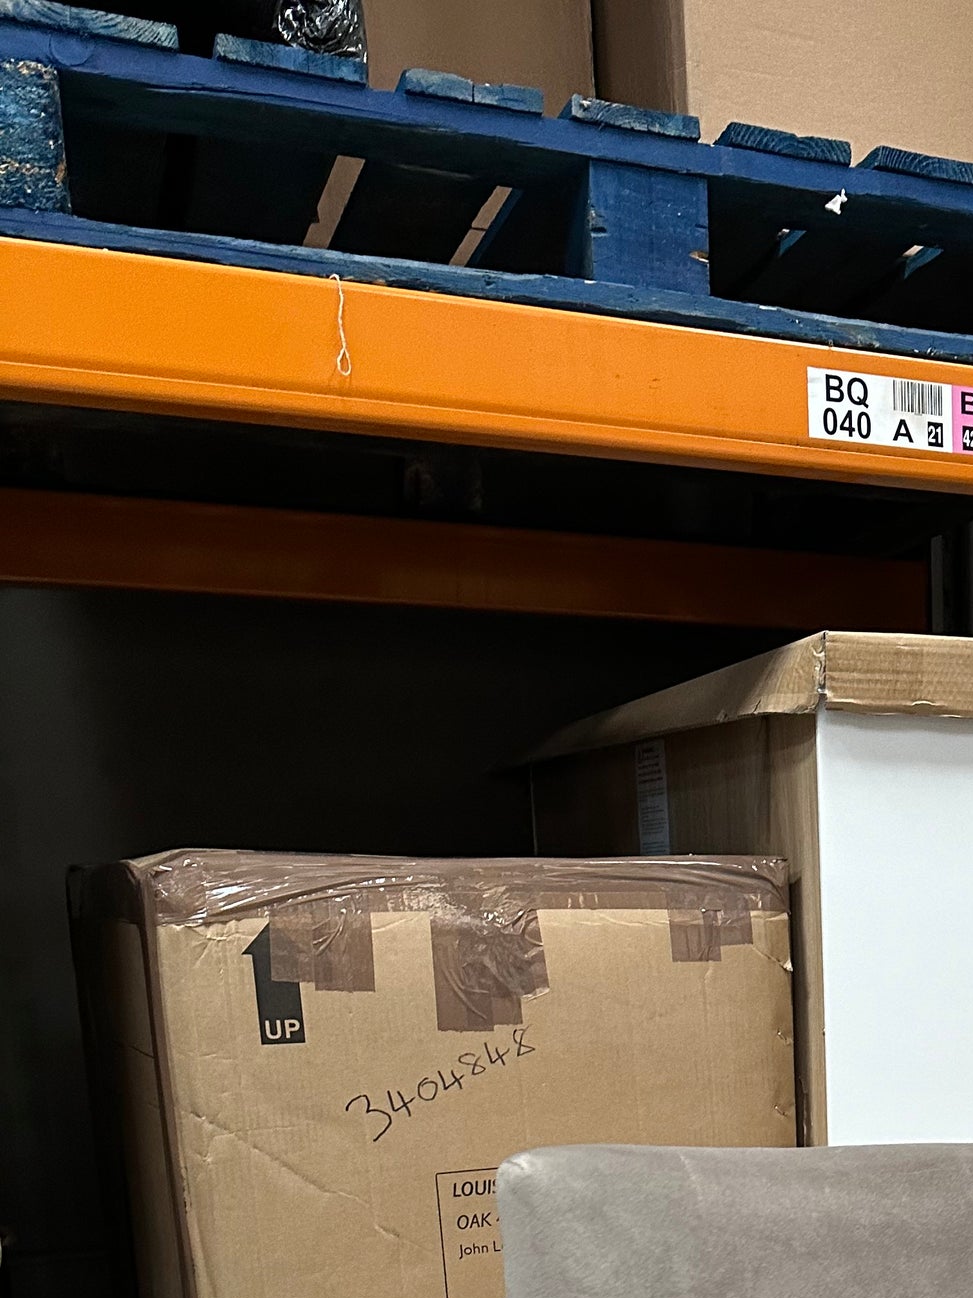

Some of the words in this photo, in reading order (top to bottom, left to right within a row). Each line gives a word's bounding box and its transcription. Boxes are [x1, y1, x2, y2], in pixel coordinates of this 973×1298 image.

[825, 374, 869, 409] BQ
[823, 407, 871, 439] 040
[892, 419, 914, 443] A
[928, 425, 942, 444] 21
[264, 1018, 301, 1041] UP
[345, 1025, 536, 1142] 3404848
[457, 1212, 492, 1230] OAK
[459, 1243, 489, 1260] John
